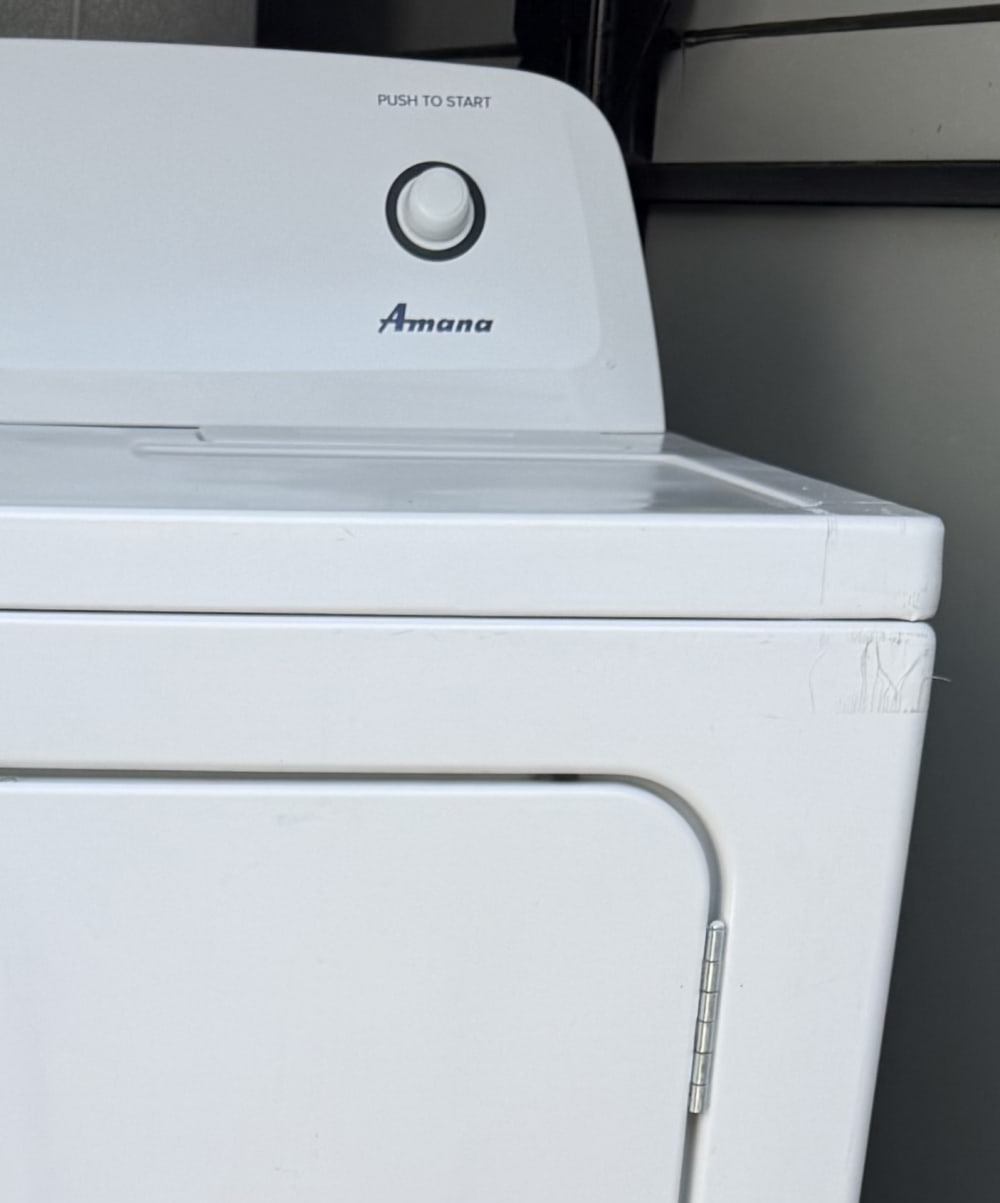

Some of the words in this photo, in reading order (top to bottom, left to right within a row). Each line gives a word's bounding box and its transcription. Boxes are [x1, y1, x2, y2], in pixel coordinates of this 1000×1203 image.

[378, 94, 418, 106] PUSH
[423, 95, 443, 107] TO
[447, 96, 492, 108] START
[378, 303, 493, 334] Amana
